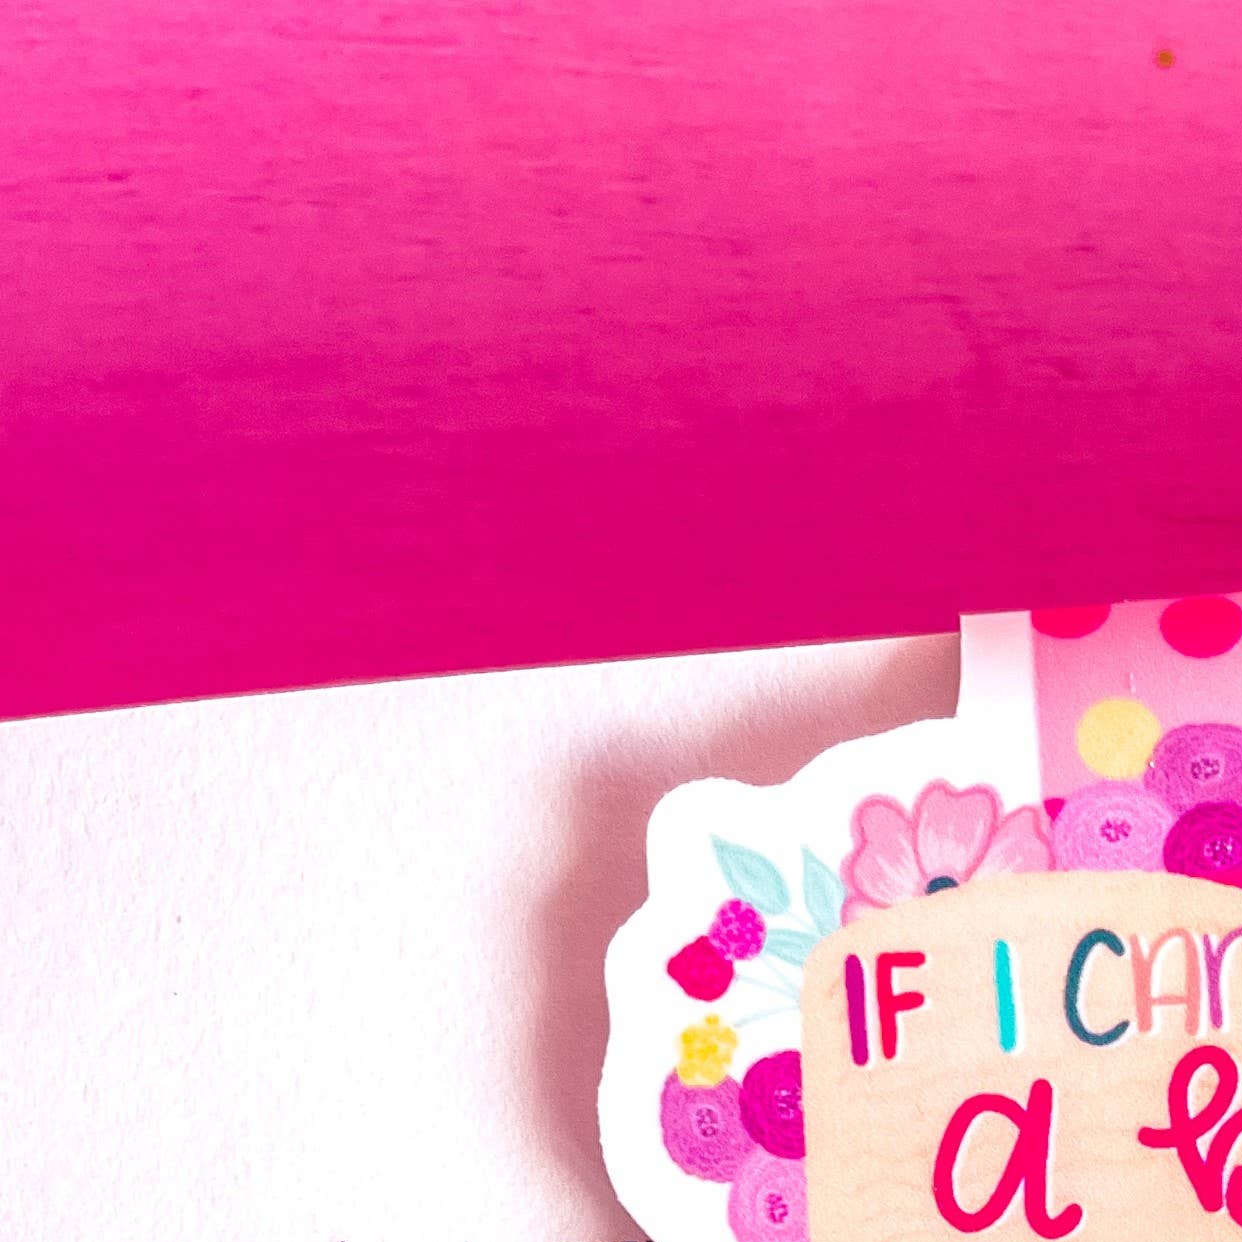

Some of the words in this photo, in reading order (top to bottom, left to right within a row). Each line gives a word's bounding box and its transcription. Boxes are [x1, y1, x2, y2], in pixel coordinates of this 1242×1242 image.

[845, 952, 926, 1066] IF
[994, 939, 1015, 1052] I
[932, 1078, 1084, 1240] a
